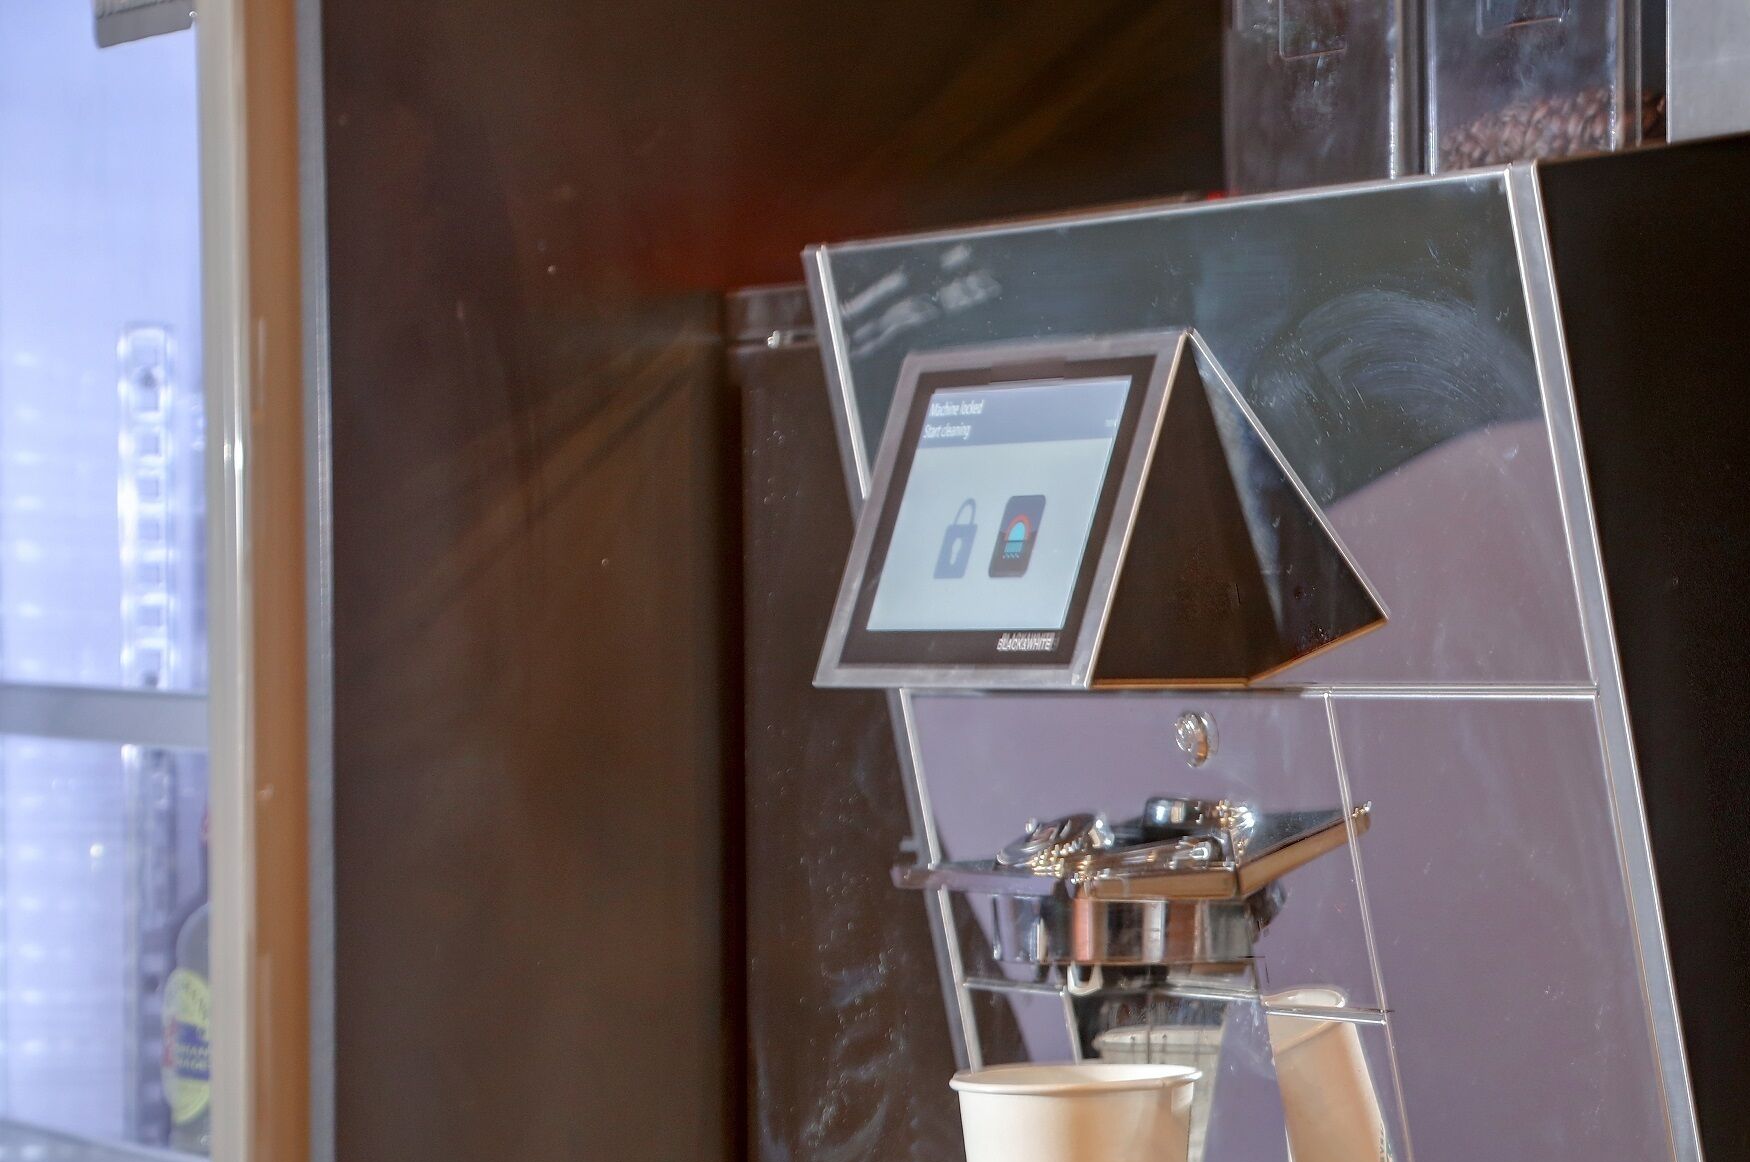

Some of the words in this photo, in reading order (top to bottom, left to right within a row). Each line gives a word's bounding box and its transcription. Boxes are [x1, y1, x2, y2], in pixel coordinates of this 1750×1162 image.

[929, 402, 960, 417] Machine
[961, 400, 984, 415] locked
[924, 425, 940, 438] Start
[941, 424, 971, 440] cleaning
[996, 637, 1053, 651] BLACK&WHITE
